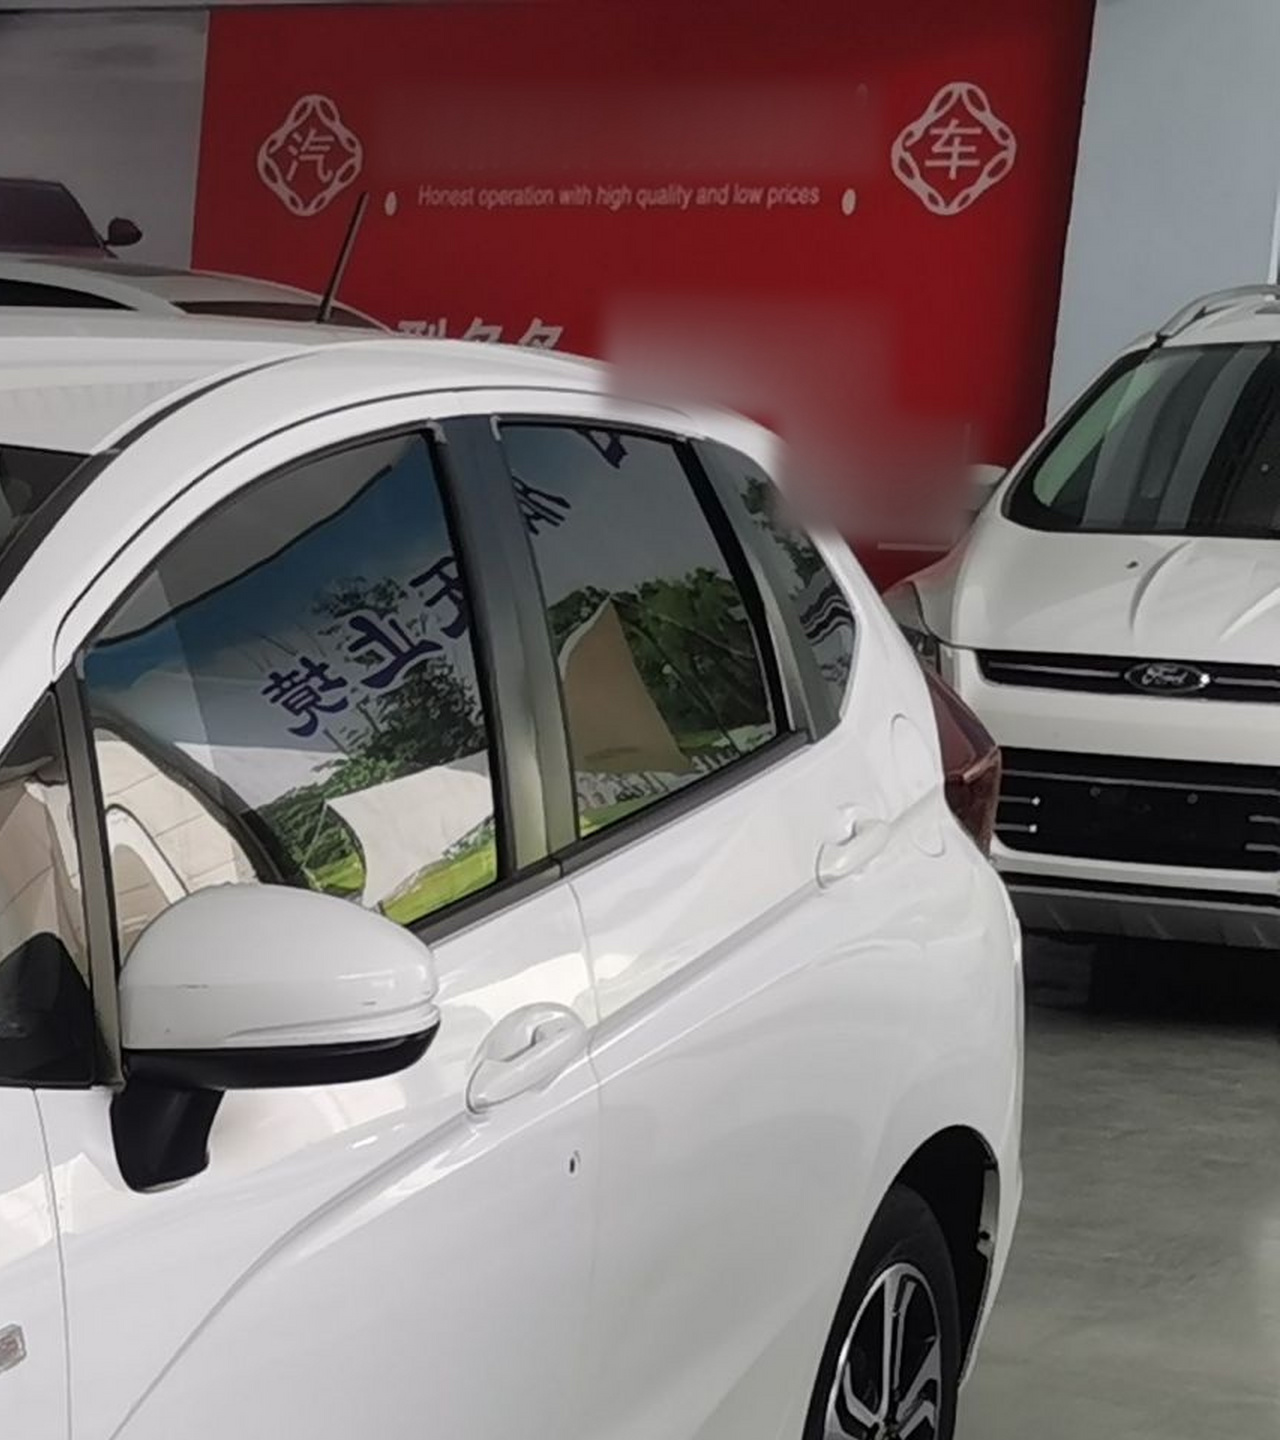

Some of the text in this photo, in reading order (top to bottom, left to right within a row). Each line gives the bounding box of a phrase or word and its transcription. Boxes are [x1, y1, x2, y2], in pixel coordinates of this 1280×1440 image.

[288, 127, 335, 183] 汽
[924, 118, 982, 180] 车
[418, 183, 821, 212] Honest operation with high quality and low prices
